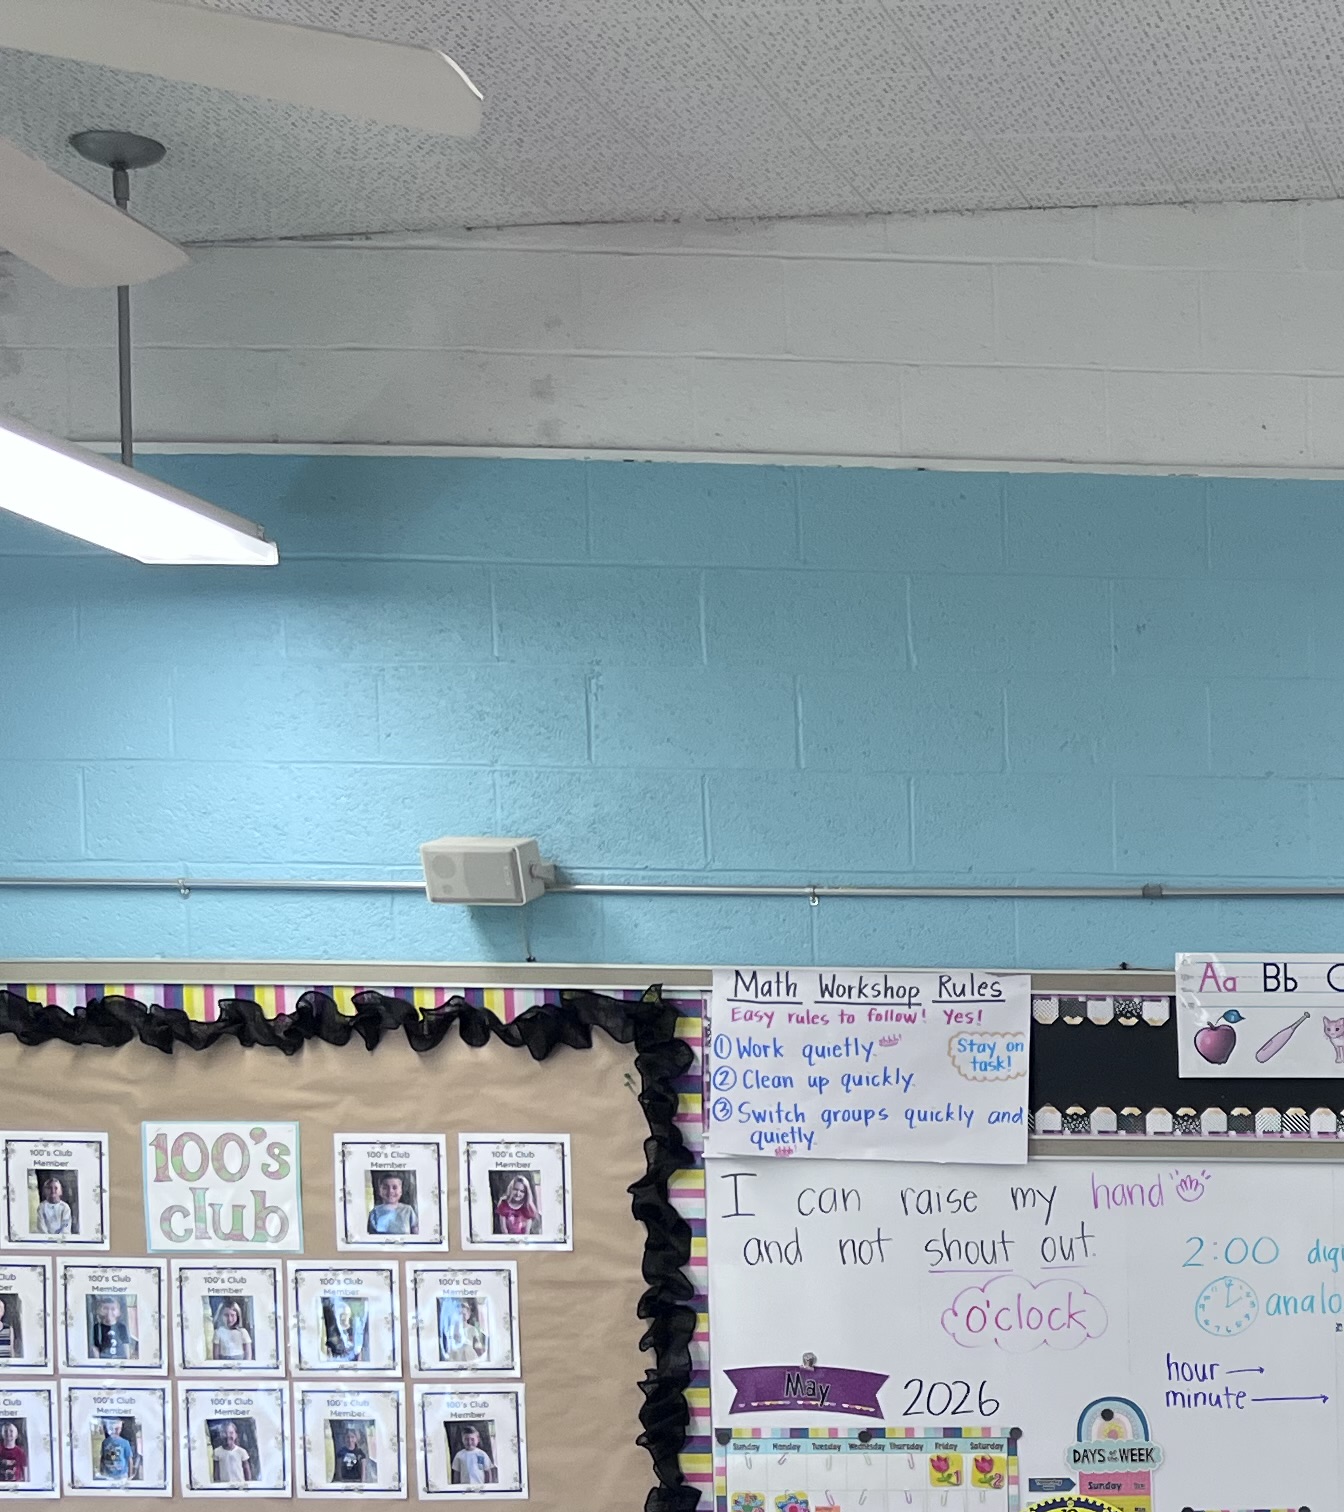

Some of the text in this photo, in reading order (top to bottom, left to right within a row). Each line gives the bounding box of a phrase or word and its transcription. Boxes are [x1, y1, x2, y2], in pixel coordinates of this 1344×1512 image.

[734, 970, 1002, 1006] Math Workshop Rules
[732, 1008, 983, 1028] Easy rules to follow! Yes!
[737, 1038, 784, 1058] Work
[957, 1038, 1024, 1056] Stay on
[970, 1054, 1011, 1073] task!
[742, 1071, 793, 1089] Clean
[808, 1075, 830, 1093] up
[738, 1102, 1023, 1127] Switch groups quickly and
[150, 1128, 290, 1183] 100's
[366, 1150, 410, 1159] 100's Club
[370, 1161, 406, 1170] Member
[721, 1172, 1163, 1225] I can raise my hand
[160, 1187, 288, 1244] club
[743, 1228, 803, 1265] and
[839, 1228, 892, 1264] not
[924, 1229, 1015, 1266] shout
[1183, 1235, 1280, 1268] 2:00
[966, 1293, 1087, 1333] o'clock
[1166, 1354, 1219, 1382] hour
[785, 1372, 830, 1405] May
[903, 1378, 999, 1416] 2026
[1165, 1388, 1247, 1409] minute
[1073, 1449, 1155, 1463] DAYS WEEK
[1088, 1482, 1122, 1490] Sunday
